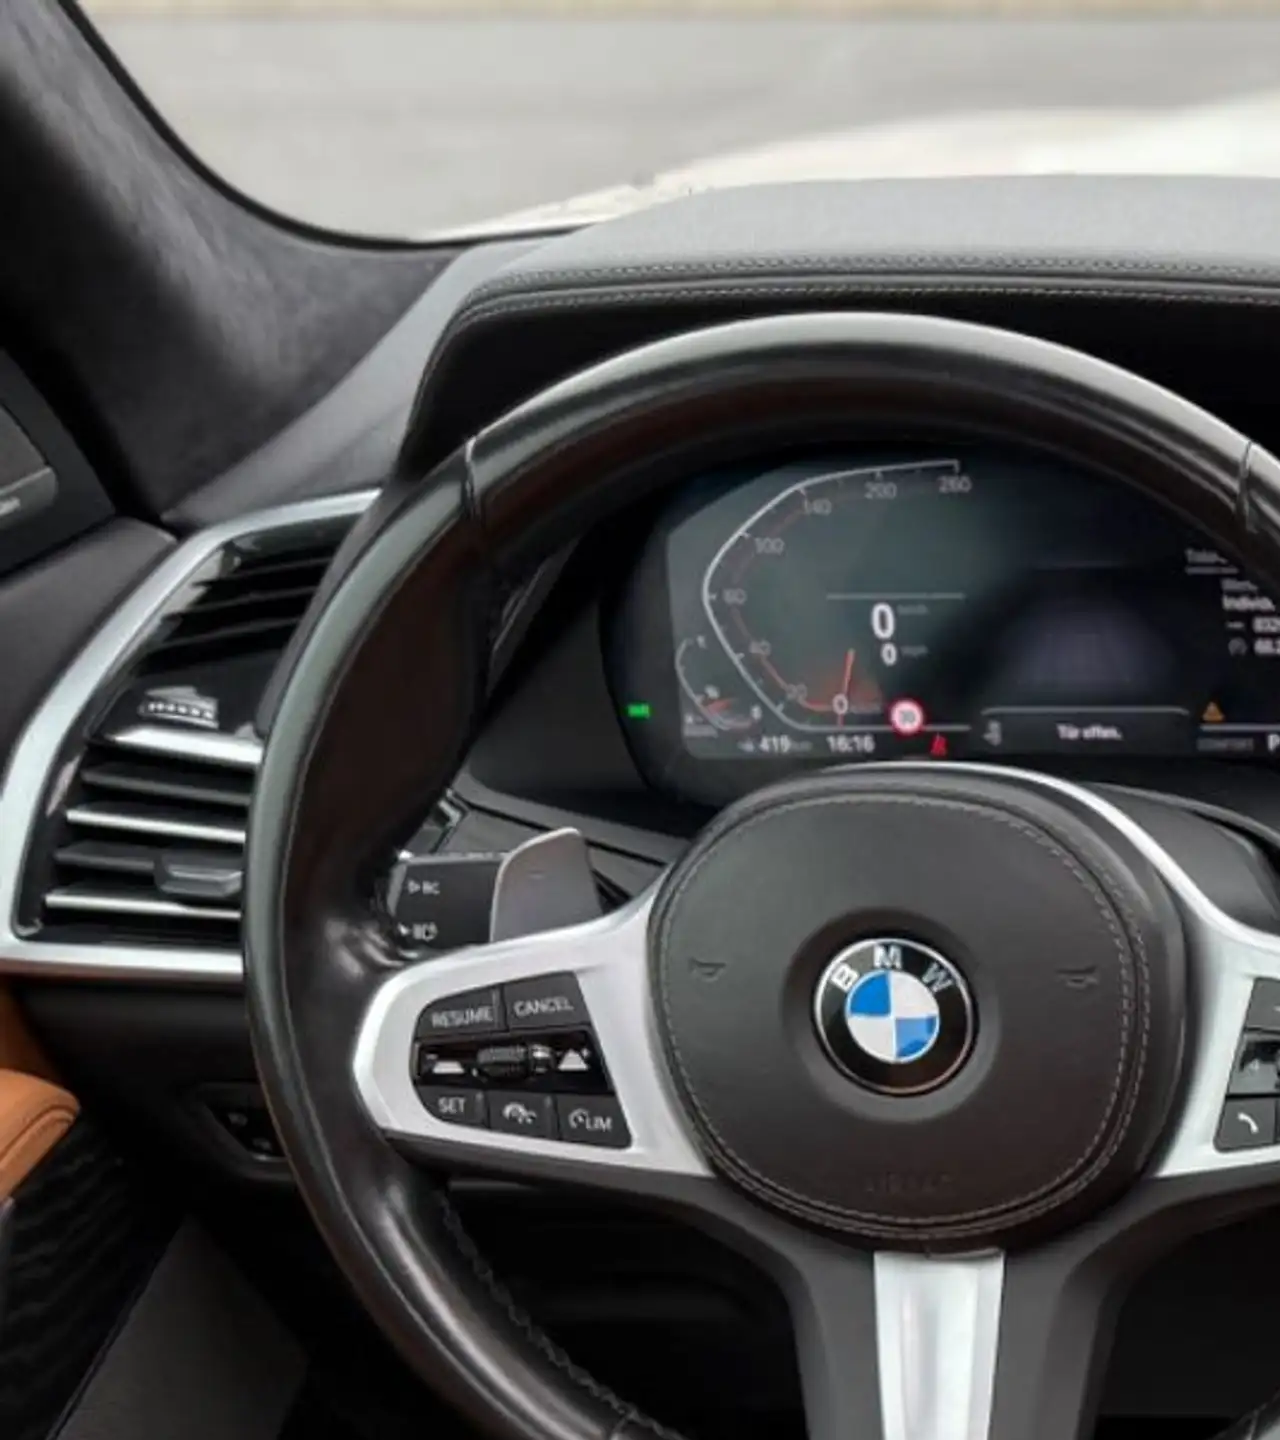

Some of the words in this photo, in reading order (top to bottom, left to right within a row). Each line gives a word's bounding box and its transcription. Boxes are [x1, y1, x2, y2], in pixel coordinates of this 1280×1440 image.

[870, 603, 895, 639] 0
[881, 643, 898, 666] 0
[826, 734, 876, 752] 16:16
[831, 944, 954, 994] BMW
[431, 1004, 494, 1027] RESUME
[513, 996, 574, 1018] CANCEL
[438, 1097, 465, 1114] SET
[586, 1114, 613, 1130] LIM
